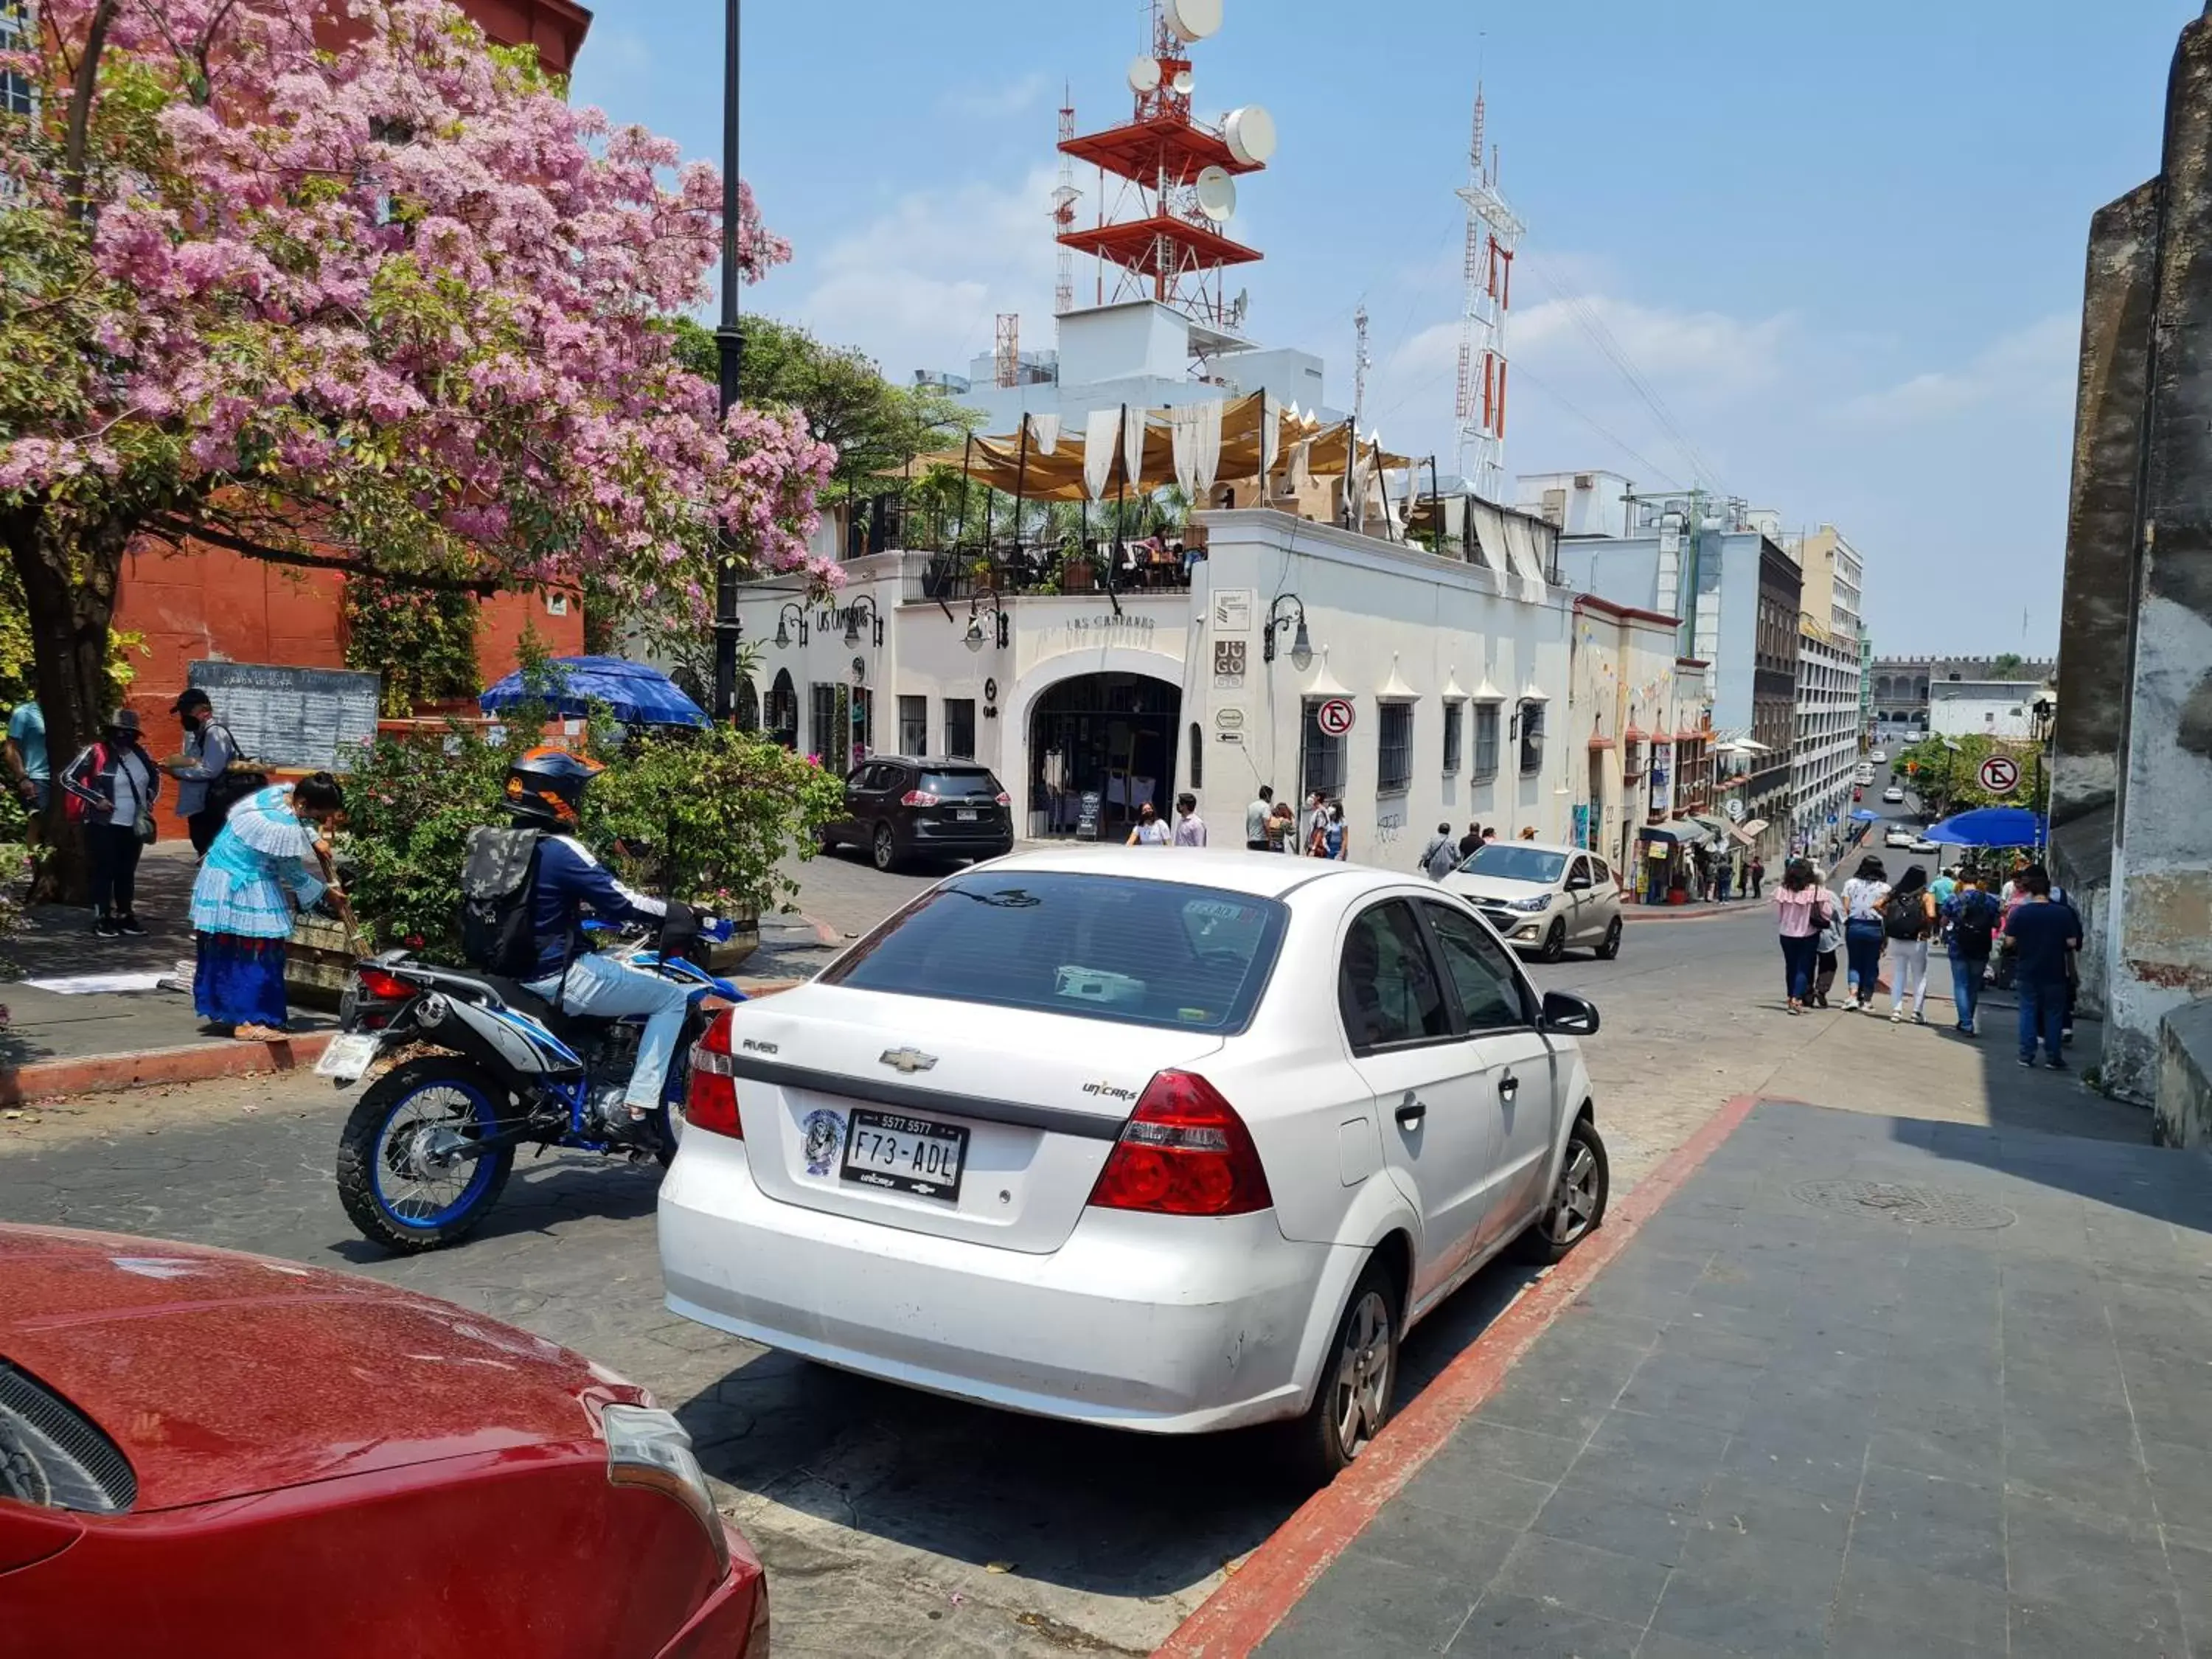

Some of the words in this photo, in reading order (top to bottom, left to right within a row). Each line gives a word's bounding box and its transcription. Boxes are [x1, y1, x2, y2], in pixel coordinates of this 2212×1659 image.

[1067, 618, 1089, 630] LAS
[1094, 615, 1155, 629] CAMPANAS
[743, 1038, 779, 1054] AVEO
[882, 1115, 905, 1130] 5577
[907, 1120, 932, 1135] 5577
[855, 1130, 951, 1178] F73-ADL
